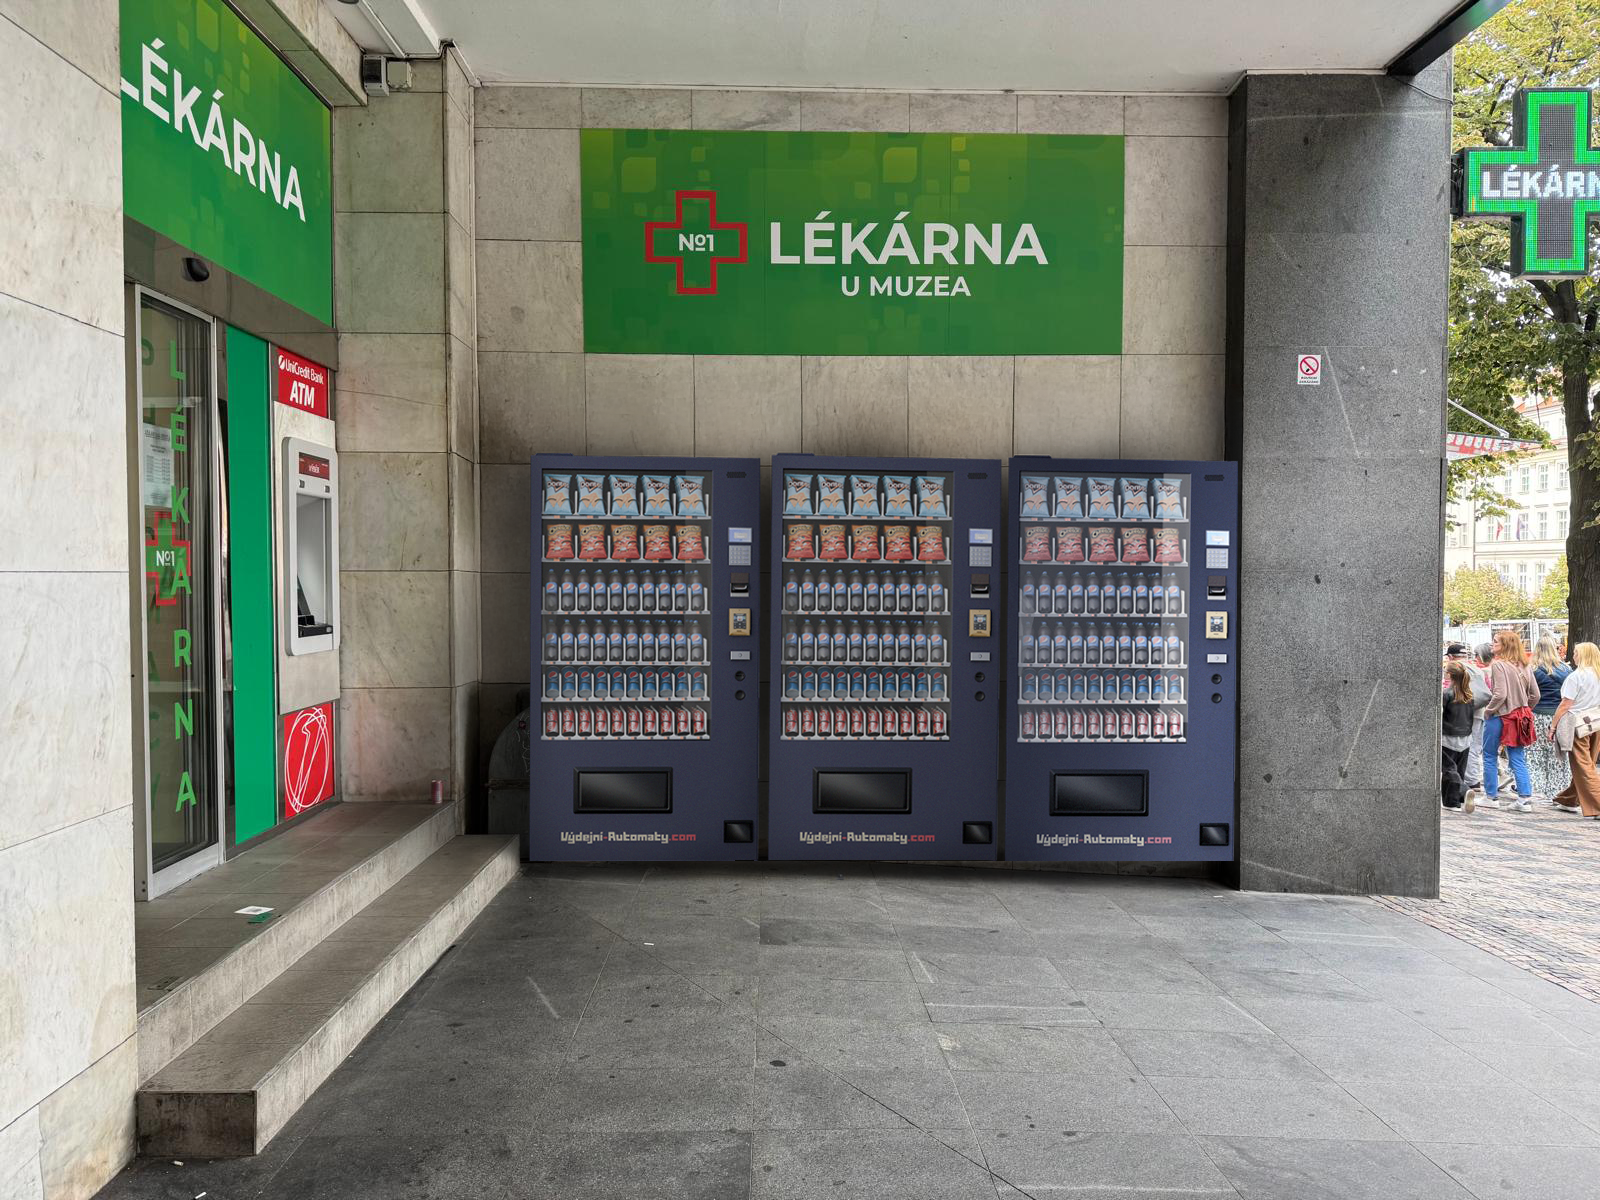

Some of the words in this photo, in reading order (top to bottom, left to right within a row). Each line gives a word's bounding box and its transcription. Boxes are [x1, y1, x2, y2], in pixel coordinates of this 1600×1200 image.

[770, 210, 1049, 265] LÉKÁRNA
[841, 275, 860, 297] U
[870, 275, 972, 297] MUZEA
[285, 358, 310, 380] UniCredit
[310, 369, 324, 385] Bank
[289, 380, 315, 409] ATM
[560, 831, 697, 845] Výdejní-Automaty.com
[799, 831, 936, 845] Výdejní-Automaty.com
[1036, 834, 1172, 847] Výdejní-Automaty.com
